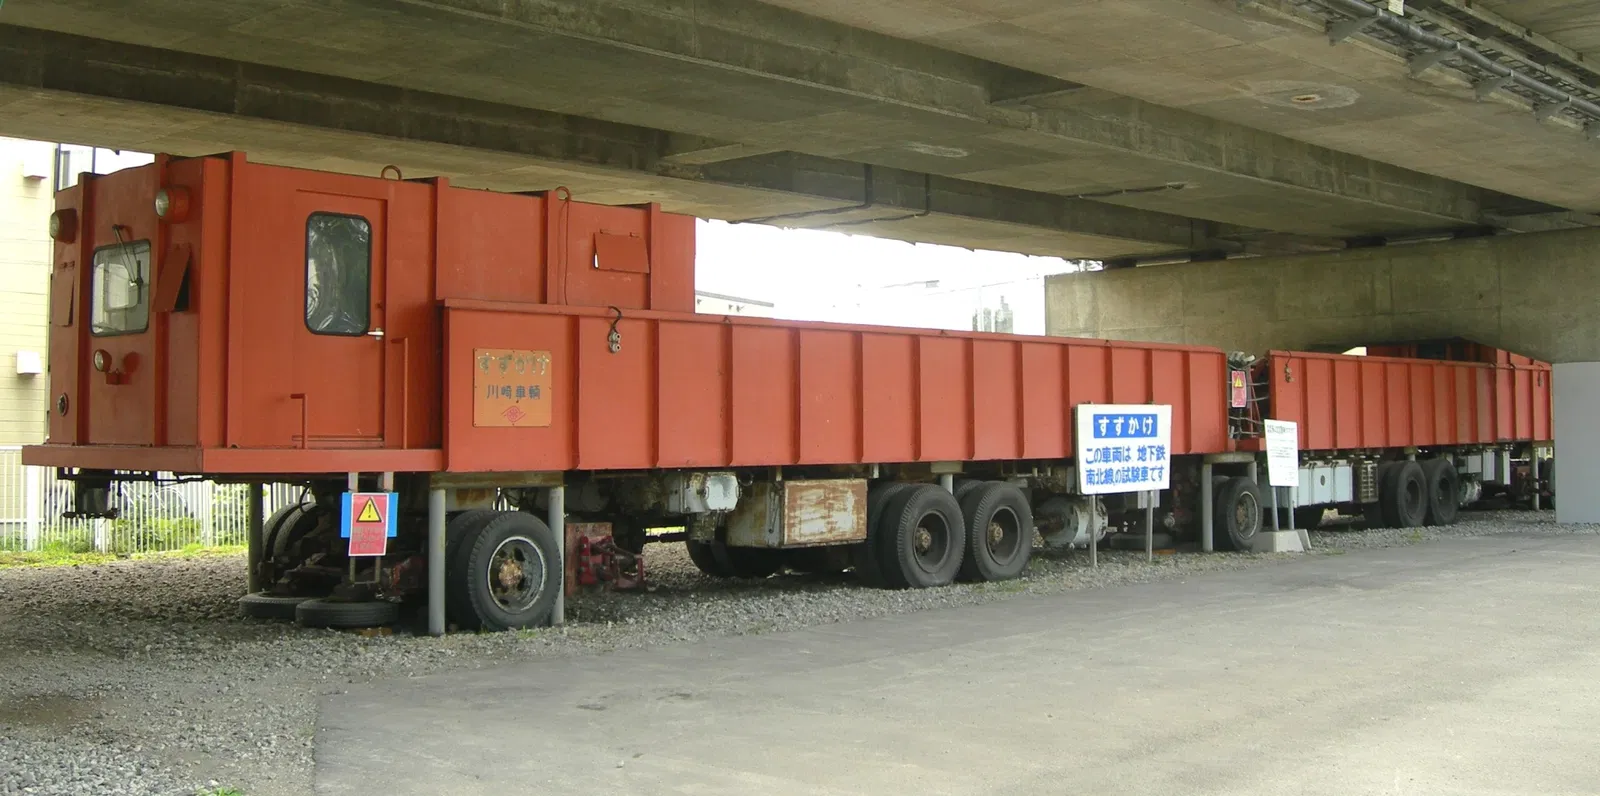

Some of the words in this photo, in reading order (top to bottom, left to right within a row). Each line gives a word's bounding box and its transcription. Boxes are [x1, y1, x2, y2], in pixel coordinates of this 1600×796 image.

[1098, 416, 1153, 436] すずかけ
[1085, 465, 1164, 486] 南北線の試験車です
